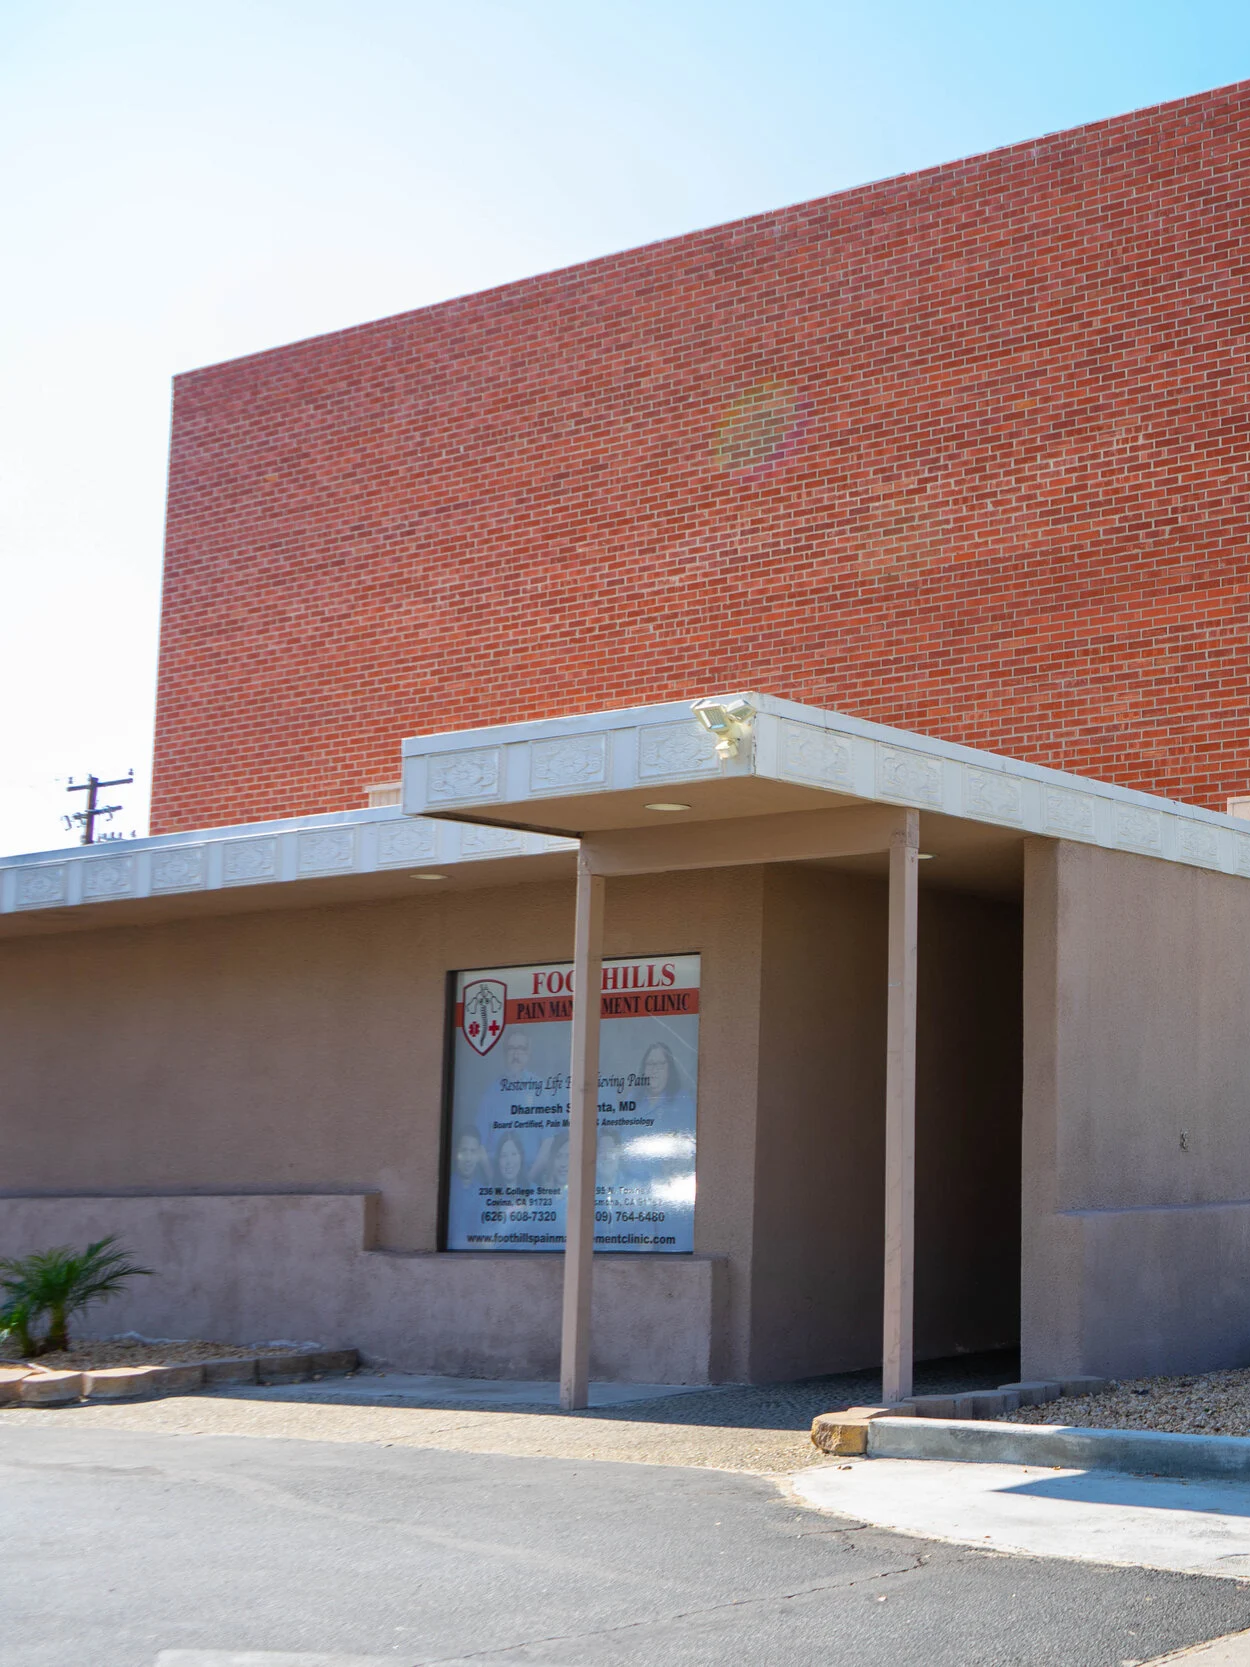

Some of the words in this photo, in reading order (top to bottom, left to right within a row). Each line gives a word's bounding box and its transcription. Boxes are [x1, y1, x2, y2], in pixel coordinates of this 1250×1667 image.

[532, 963, 676, 995] FOOHILLS
[517, 1001, 546, 1020] PAIN
[549, 996, 641, 1018] MANMENT
[644, 993, 690, 1013] CLINIC
[500, 1078, 543, 1097] Restoring
[544, 1073, 563, 1096] Life
[627, 1073, 651, 1087] Pain
[510, 1103, 563, 1115] Dharmesh
[619, 1100, 637, 1112] MD
[546, 1118, 561, 1128] Pain
[601, 1116, 655, 1127] Anesthesiology
[479, 1187, 493, 1196] 236
[505, 1187, 535, 1197] College
[537, 1186, 561, 1195] Street
[516, 1198, 527, 1206] CA
[529, 1198, 553, 1206] 91723
[481, 1211, 507, 1225] (626)
[509, 1210, 557, 1222] 608-7320
[615, 1210, 665, 1222] 764-6480
